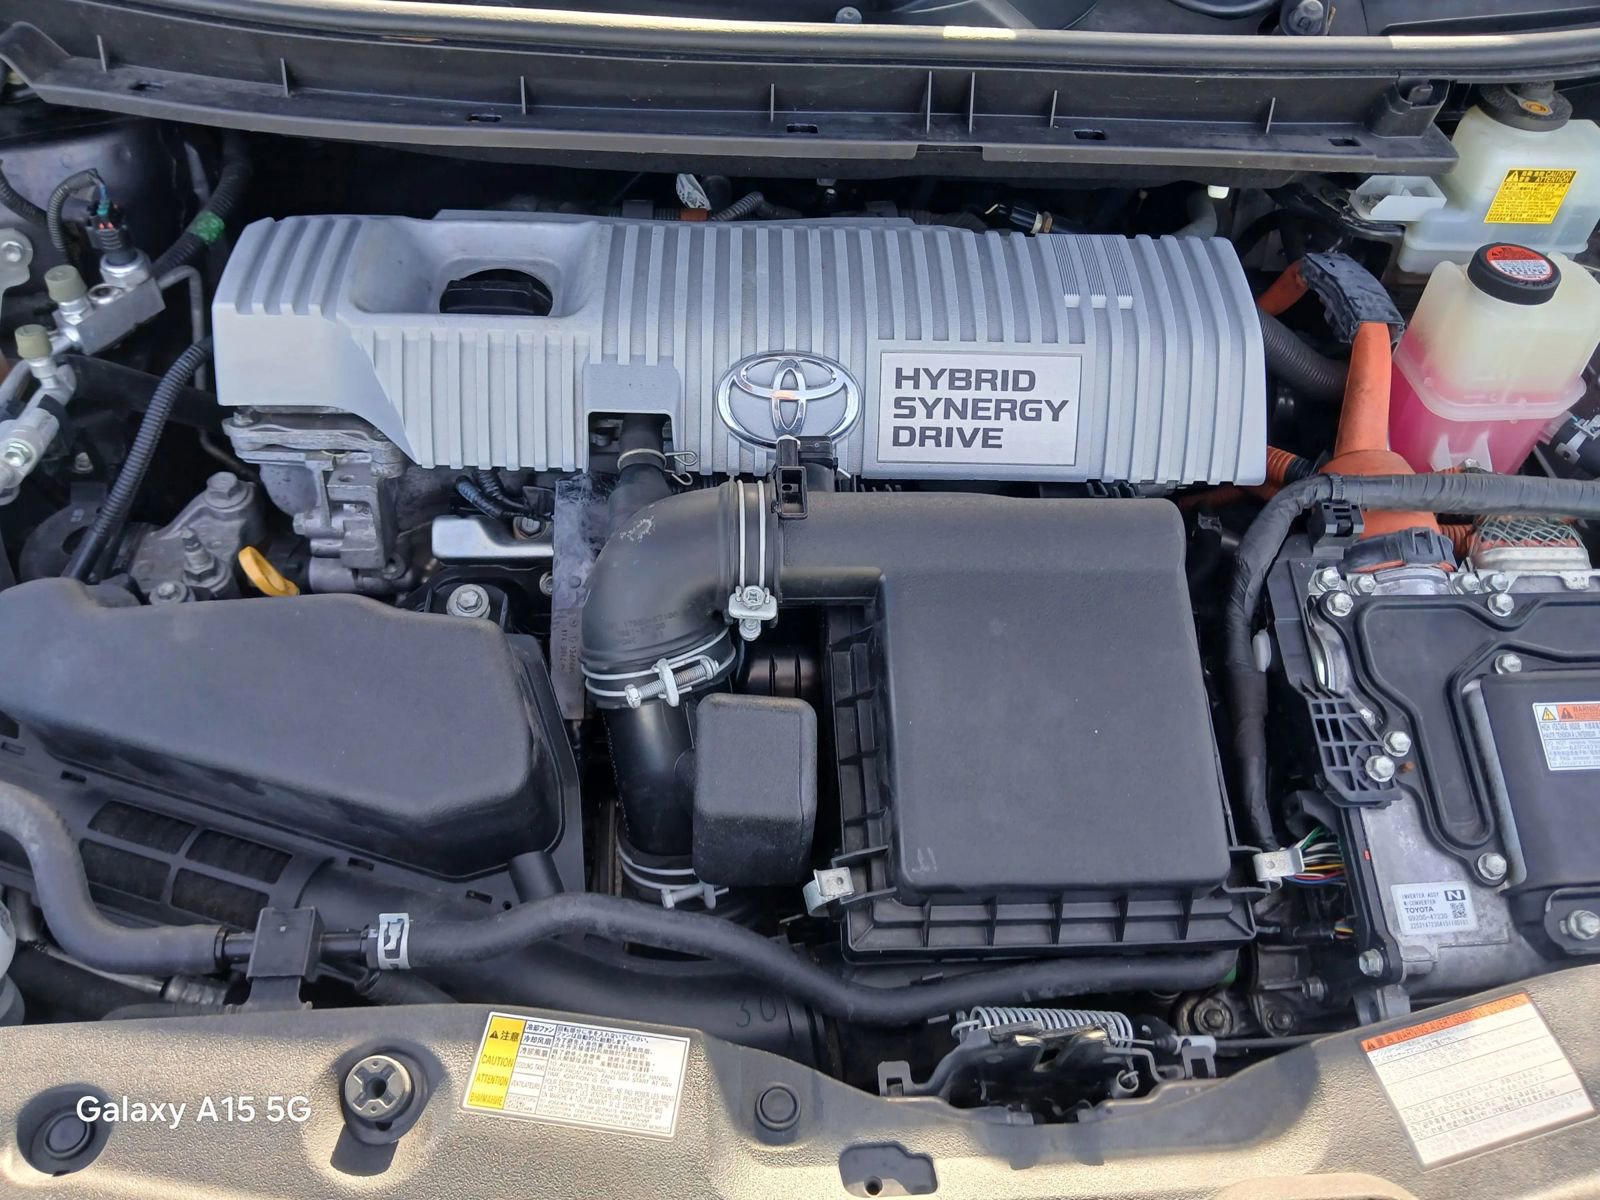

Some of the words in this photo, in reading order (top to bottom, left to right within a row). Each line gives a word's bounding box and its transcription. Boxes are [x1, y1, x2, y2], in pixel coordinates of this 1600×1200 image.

[895, 367, 1036, 392] HYBRID
[893, 396, 1069, 422] SYNERGY
[892, 425, 1004, 449] DRIVE
[1405, 906, 1434, 914] TOYOTA
[526, 1023, 554, 1033] 冷却ファン
[500, 1030, 520, 1042] 注意
[480, 1054, 514, 1067] CAUTION
[475, 1072, 509, 1086] ATTENTION
